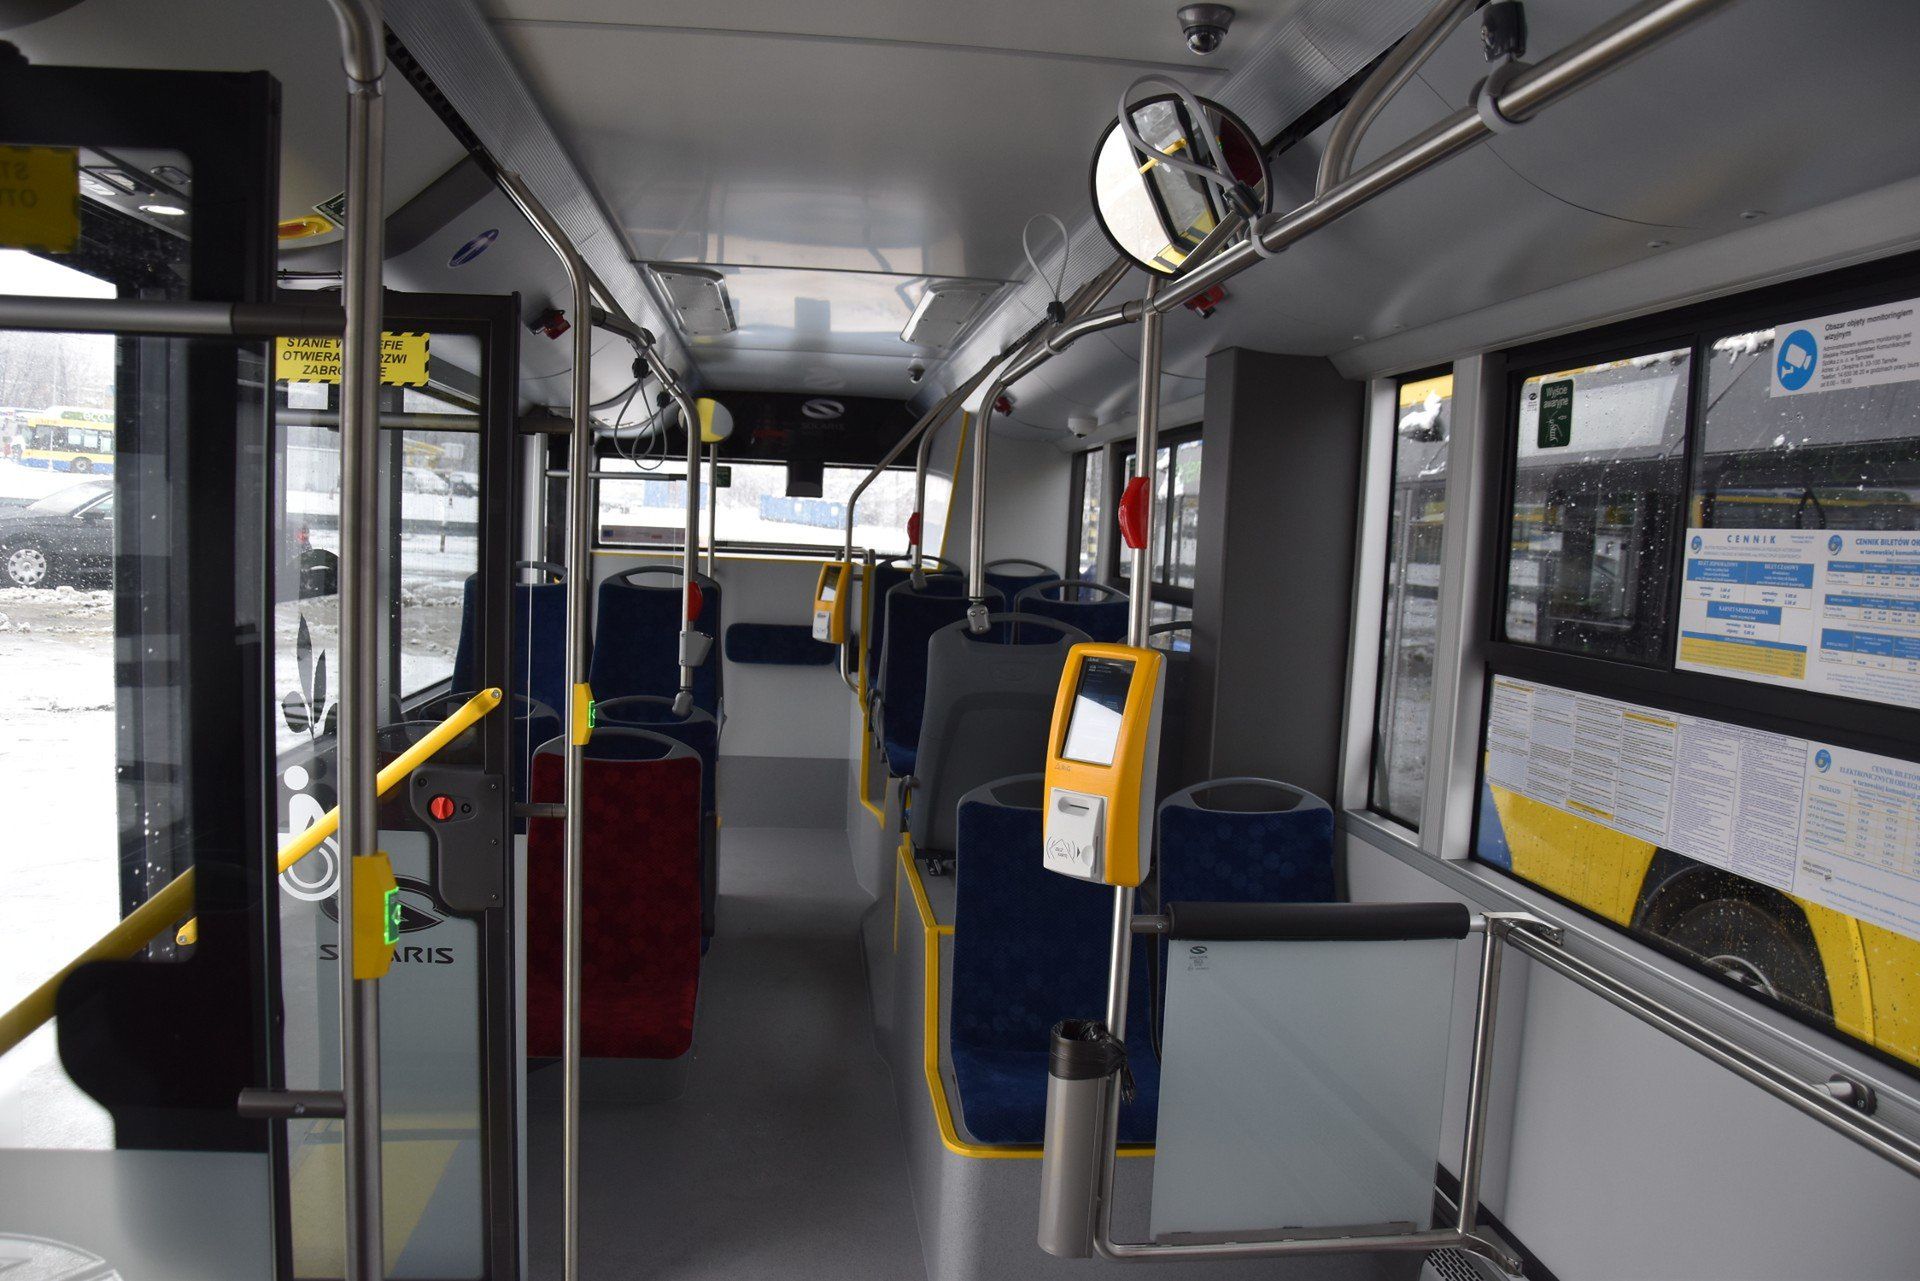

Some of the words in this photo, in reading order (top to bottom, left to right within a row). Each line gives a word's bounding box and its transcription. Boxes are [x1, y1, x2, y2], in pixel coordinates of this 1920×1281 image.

[283, 350, 340, 362] OTWIERA
[379, 353, 407, 364] RZWI
[1727, 535, 1776, 544] CENNIK
[319, 945, 454, 964] SARIS
